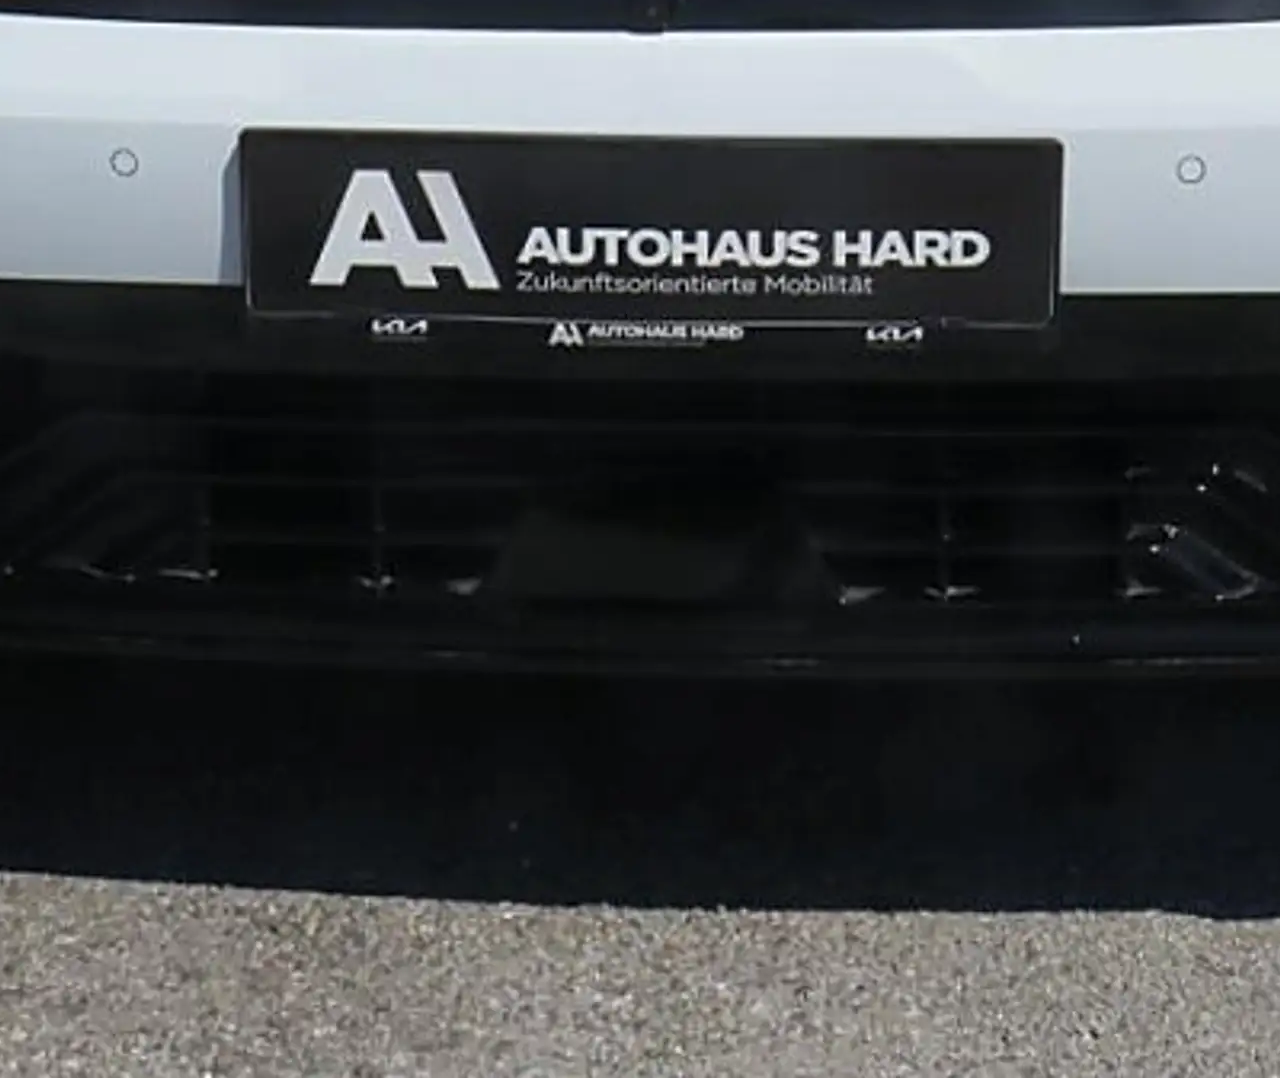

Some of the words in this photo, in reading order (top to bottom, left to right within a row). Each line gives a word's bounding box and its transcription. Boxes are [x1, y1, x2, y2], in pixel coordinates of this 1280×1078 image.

[517, 226, 820, 268] AUTOHAUS
[832, 229, 991, 268] HARD
[516, 270, 757, 296] Zukunftsorientierte
[764, 273, 875, 297] Mobilität
